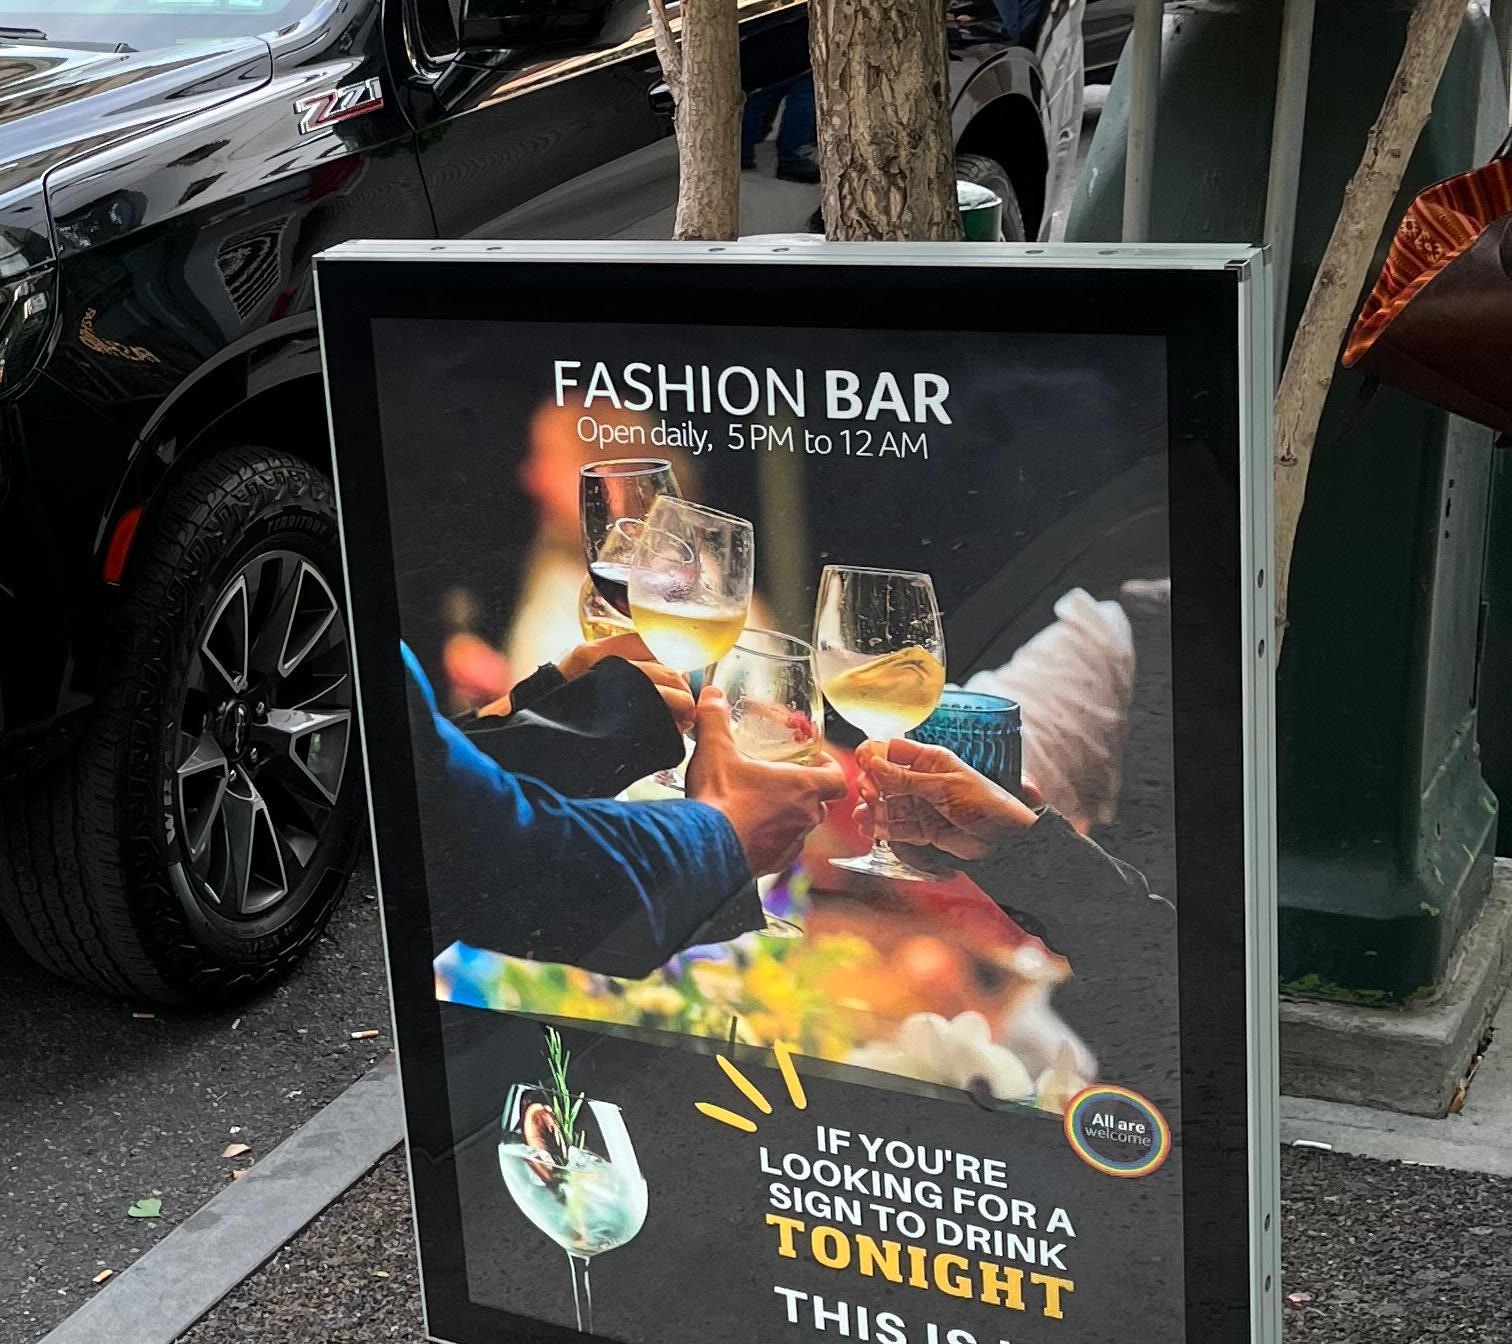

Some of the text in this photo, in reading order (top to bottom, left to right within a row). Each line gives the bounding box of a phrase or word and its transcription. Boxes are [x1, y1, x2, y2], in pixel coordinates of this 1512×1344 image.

[293, 77, 384, 135] Z71
[554, 359, 953, 426] FASHION BAR
[576, 415, 929, 460] Open daily, 5 PM to 12 AM
[1084, 1126, 1152, 1147] welcome
[1091, 1113, 1146, 1134] All are
[816, 1125, 1008, 1190] IF YOU'RE
[759, 1146, 1078, 1238] LOOKING FOR A
[768, 1183, 1069, 1271] SIGN TO DRINK
[764, 1212, 1076, 1320] TONIGHT
